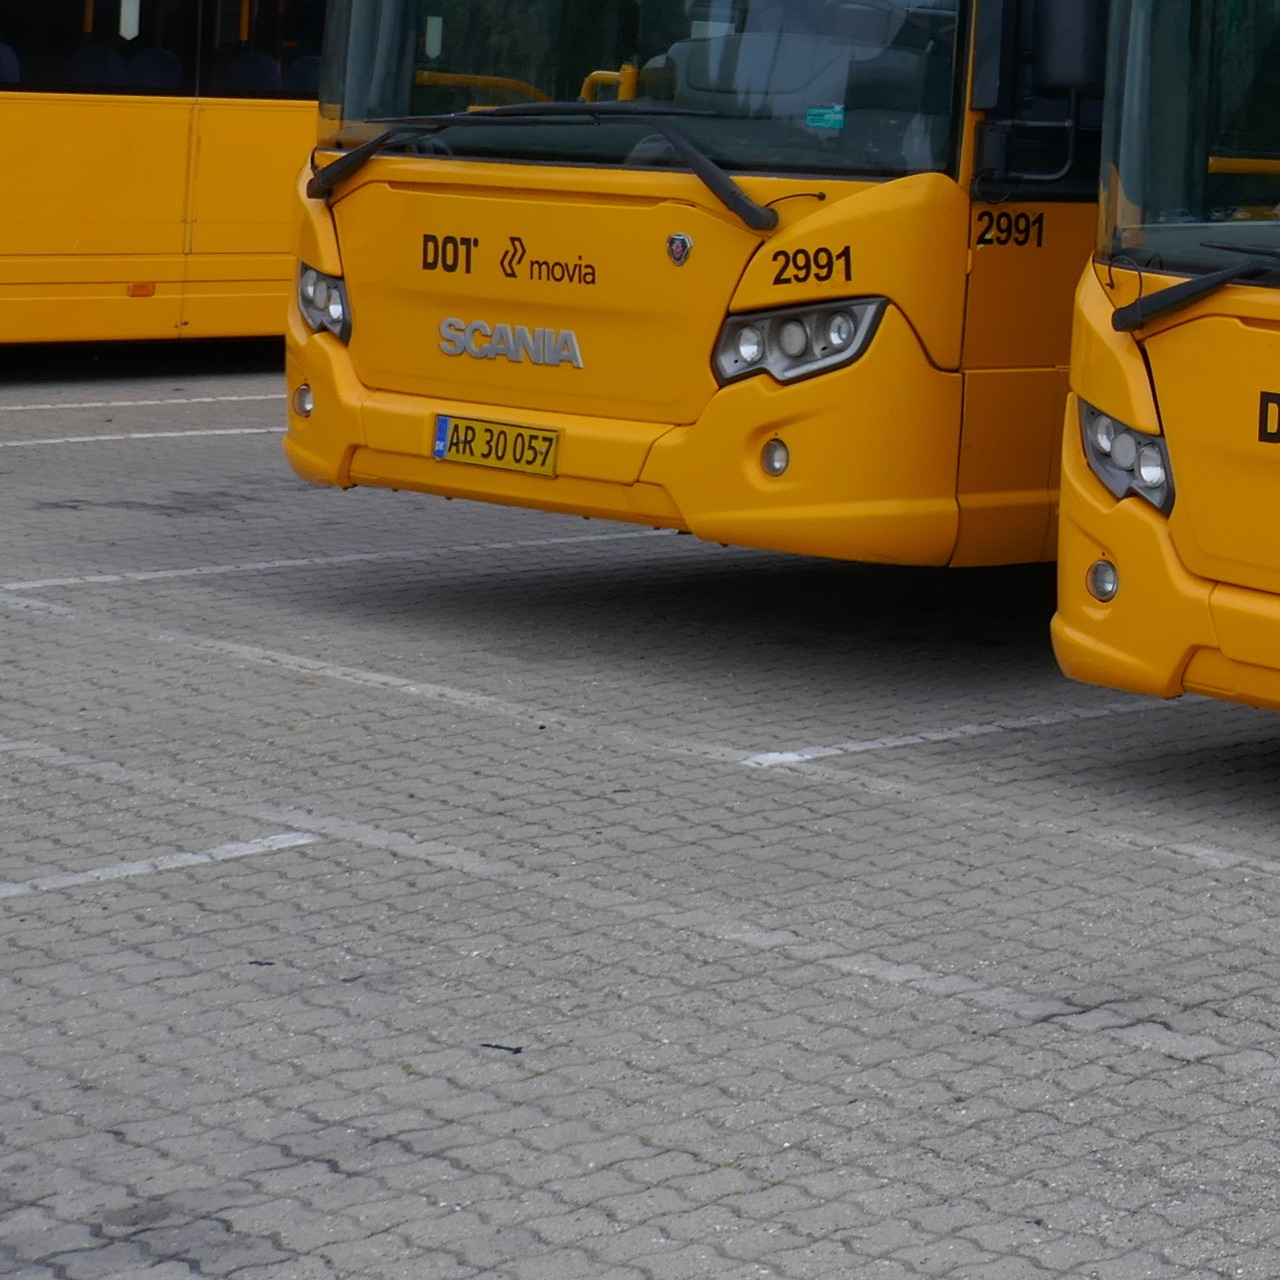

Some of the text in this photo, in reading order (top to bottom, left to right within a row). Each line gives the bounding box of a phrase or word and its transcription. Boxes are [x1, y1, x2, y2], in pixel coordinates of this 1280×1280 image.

[976, 210, 1044, 248] 2991
[422, 233, 479, 274] DOT
[530, 256, 596, 285] movia
[771, 245, 853, 286] 2991
[438, 317, 584, 369] SCANIA
[448, 423, 554, 467] AR 30 057
